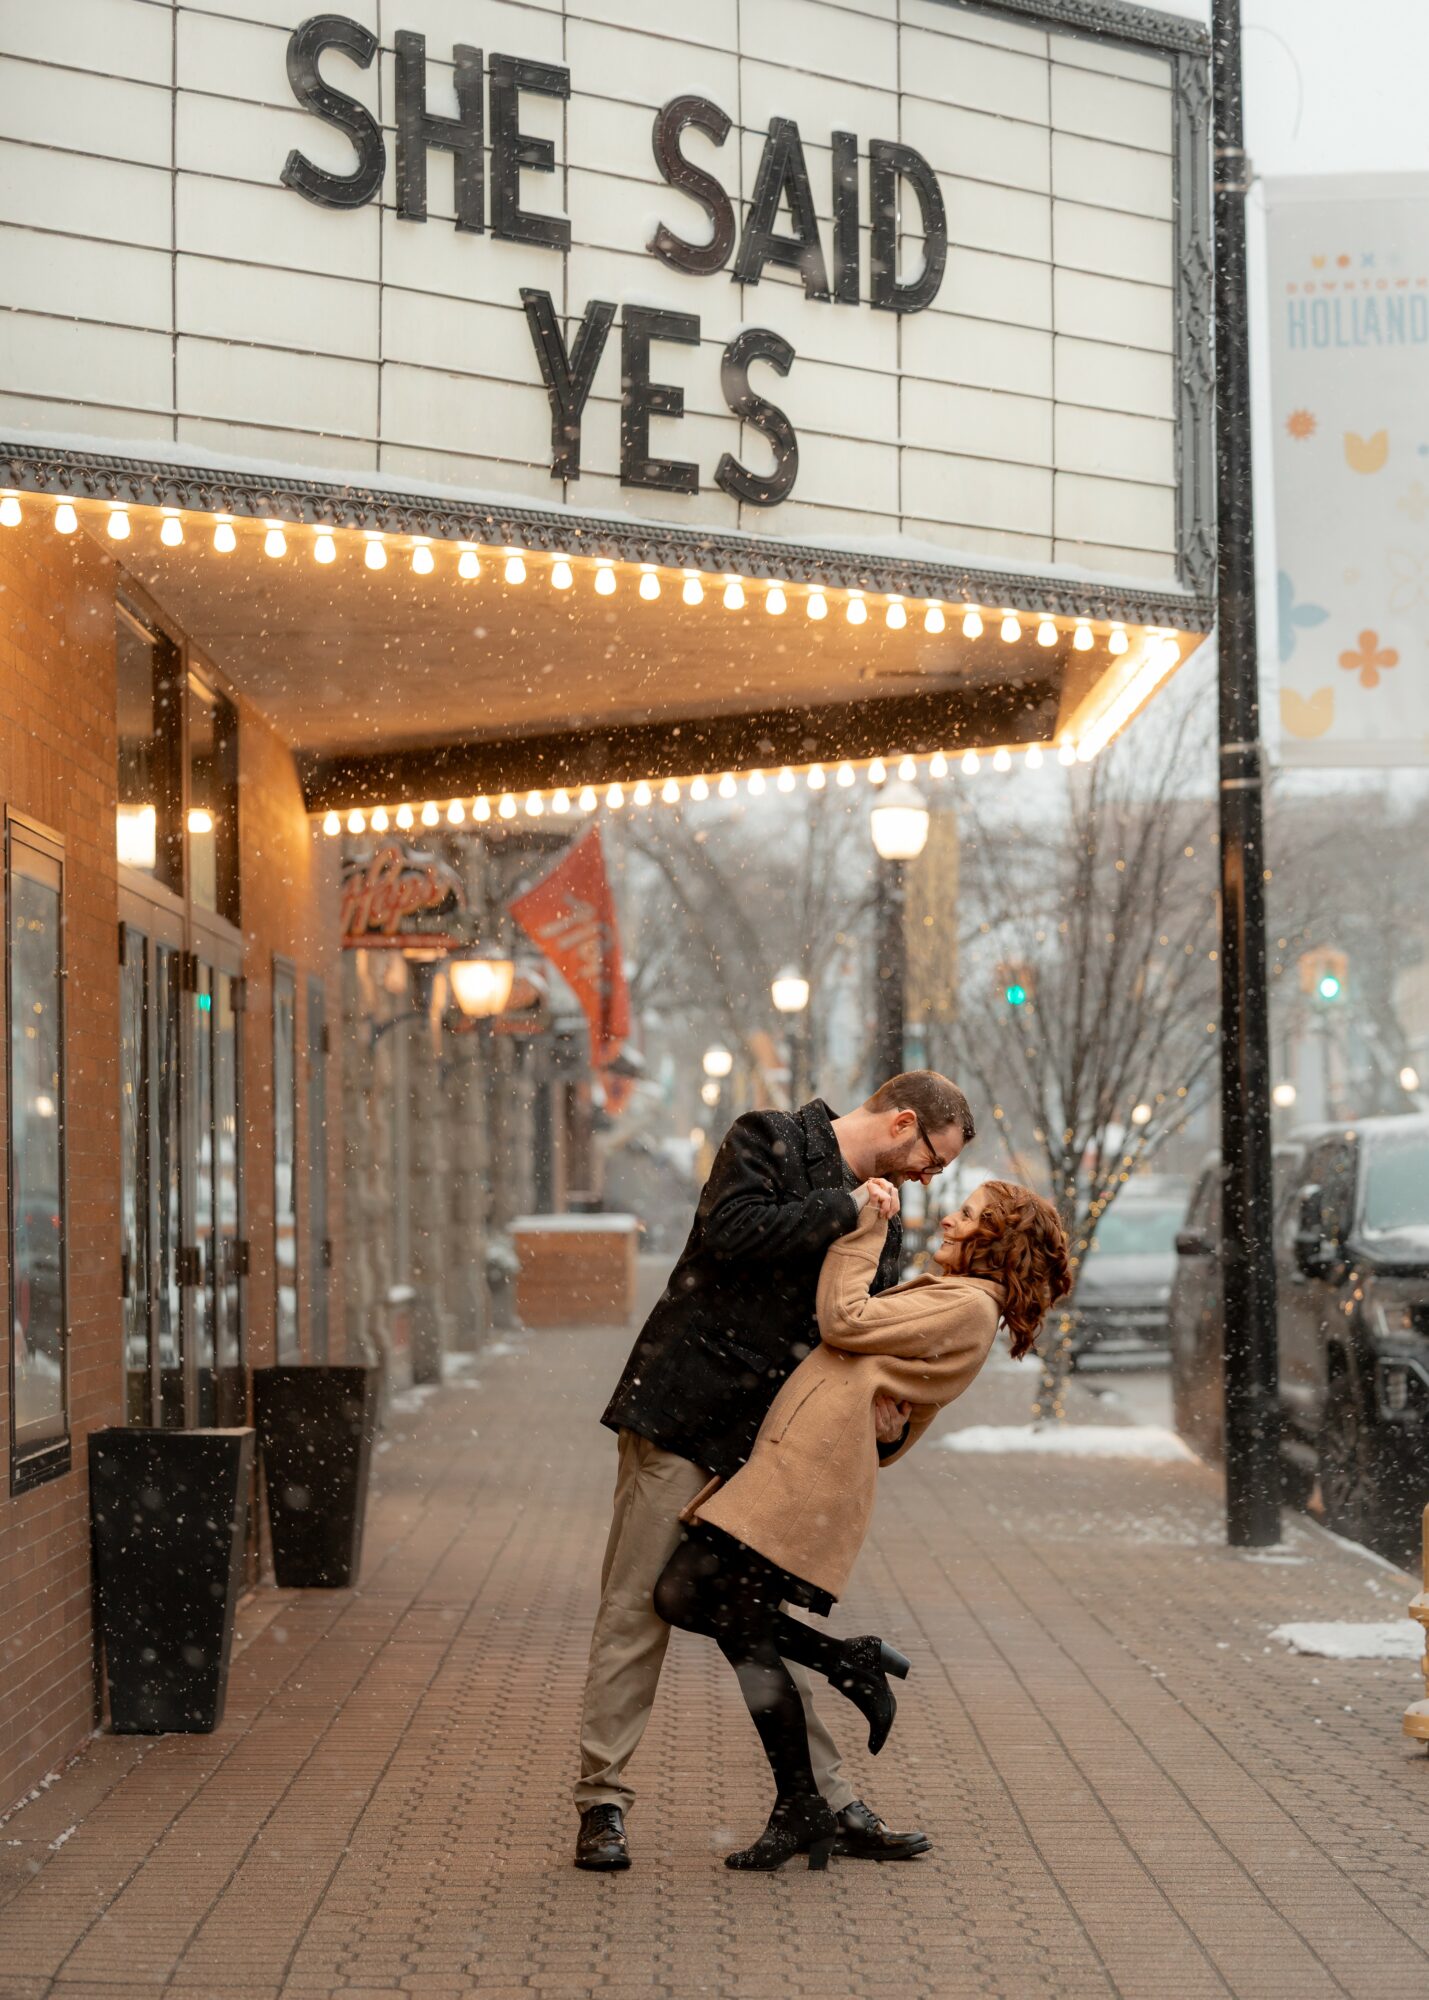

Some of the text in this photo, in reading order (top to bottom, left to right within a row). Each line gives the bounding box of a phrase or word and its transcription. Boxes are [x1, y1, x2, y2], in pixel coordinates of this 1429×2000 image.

[280, 14, 947, 313] SHE SAID
[519, 287, 797, 507] YES
[1287, 294, 1429, 349] HOLLAND
